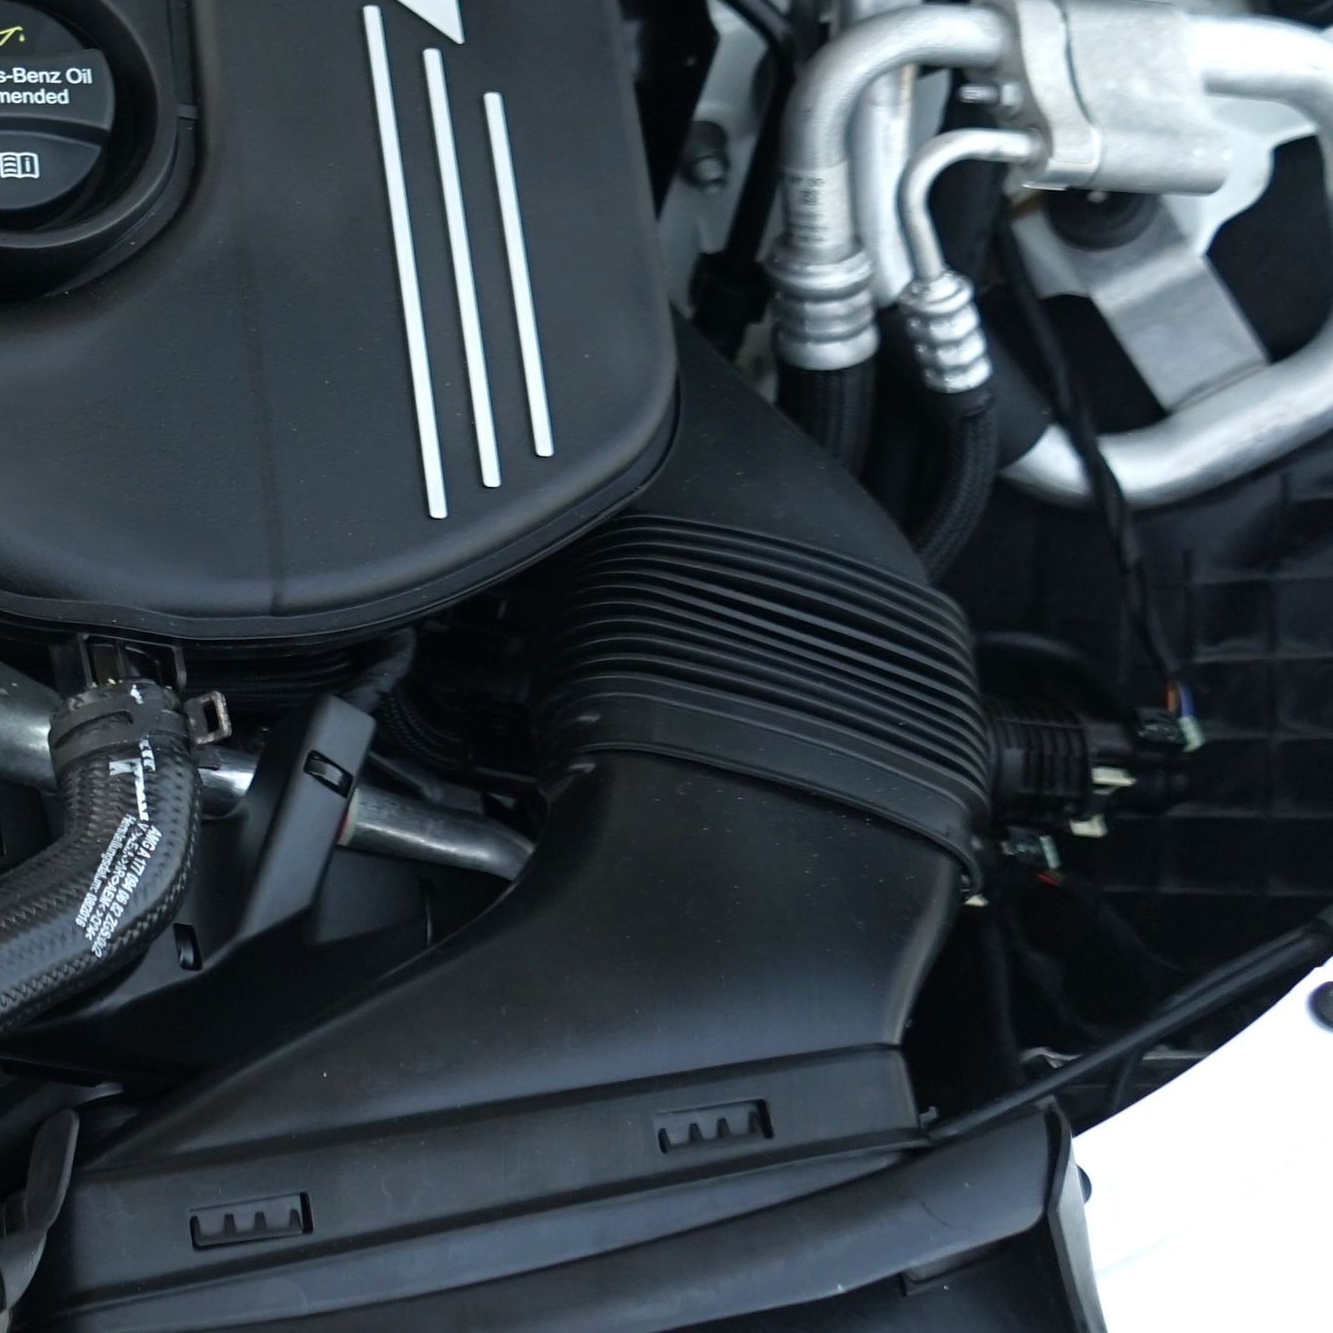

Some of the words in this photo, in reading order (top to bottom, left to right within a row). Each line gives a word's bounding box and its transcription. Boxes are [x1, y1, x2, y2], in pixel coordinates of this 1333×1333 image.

[65, 67, 93, 85] Oil
[142, 825, 163, 852] AMG
[137, 847, 151, 859] A
[130, 857, 147, 877] 177
